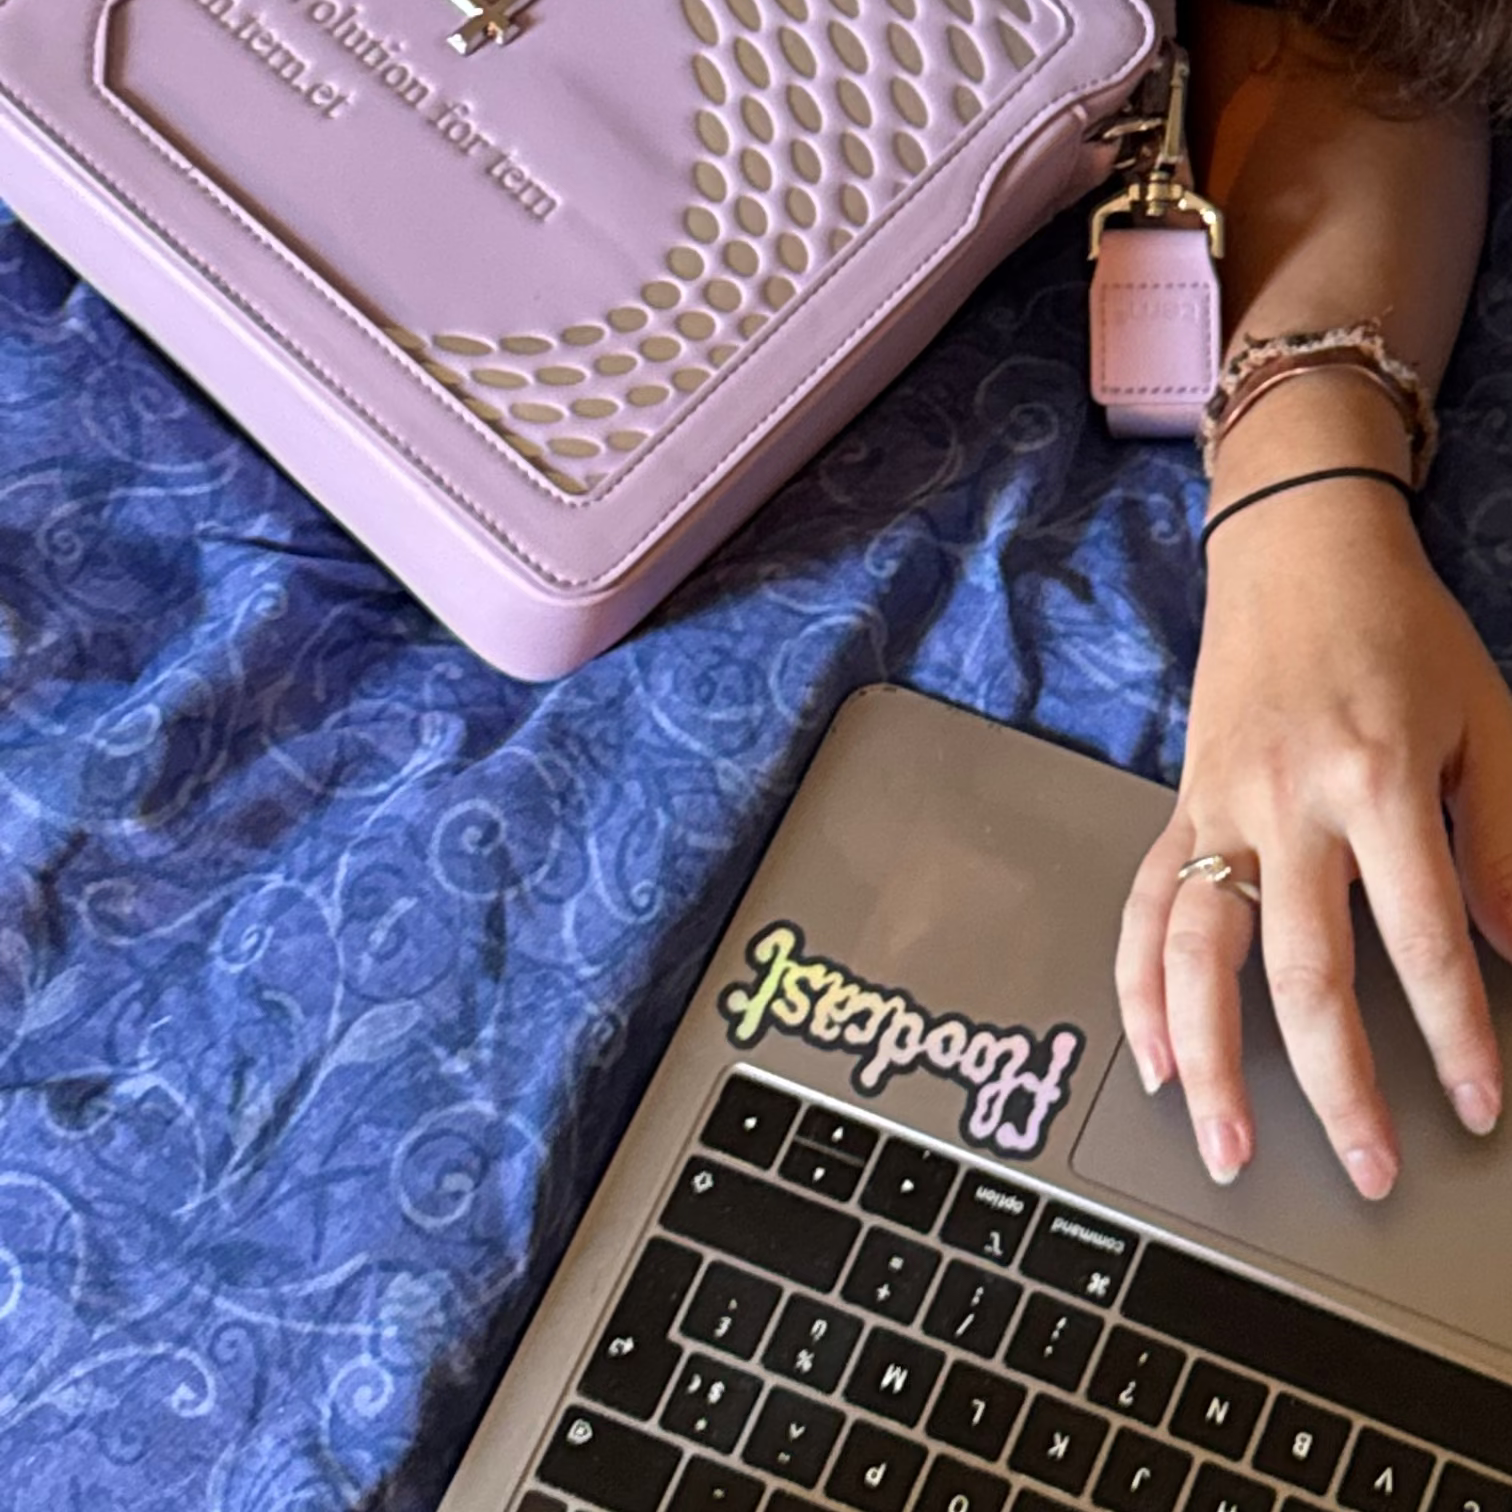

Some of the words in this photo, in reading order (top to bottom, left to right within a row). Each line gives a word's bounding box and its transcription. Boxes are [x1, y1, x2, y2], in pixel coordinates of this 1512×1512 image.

[429, 99, 497, 157] for
[720, 922, 1084, 1159] Floodcast
[974, 1184, 1026, 1215] option
[1051, 1216, 1127, 1254] command
[796, 1349, 814, 1372] %
[880, 1364, 908, 1392] M
[708, 1381, 725, 1403] $
[1118, 1381, 1136, 1405] ?
[972, 1399, 986, 1424] L
[1206, 1397, 1229, 1424] N
[1048, 1432, 1069, 1458] K
[1292, 1432, 1313, 1458] B
[865, 1463, 886, 1486] P
[1131, 1467, 1150, 1490] J
[1374, 1467, 1393, 1493] V
